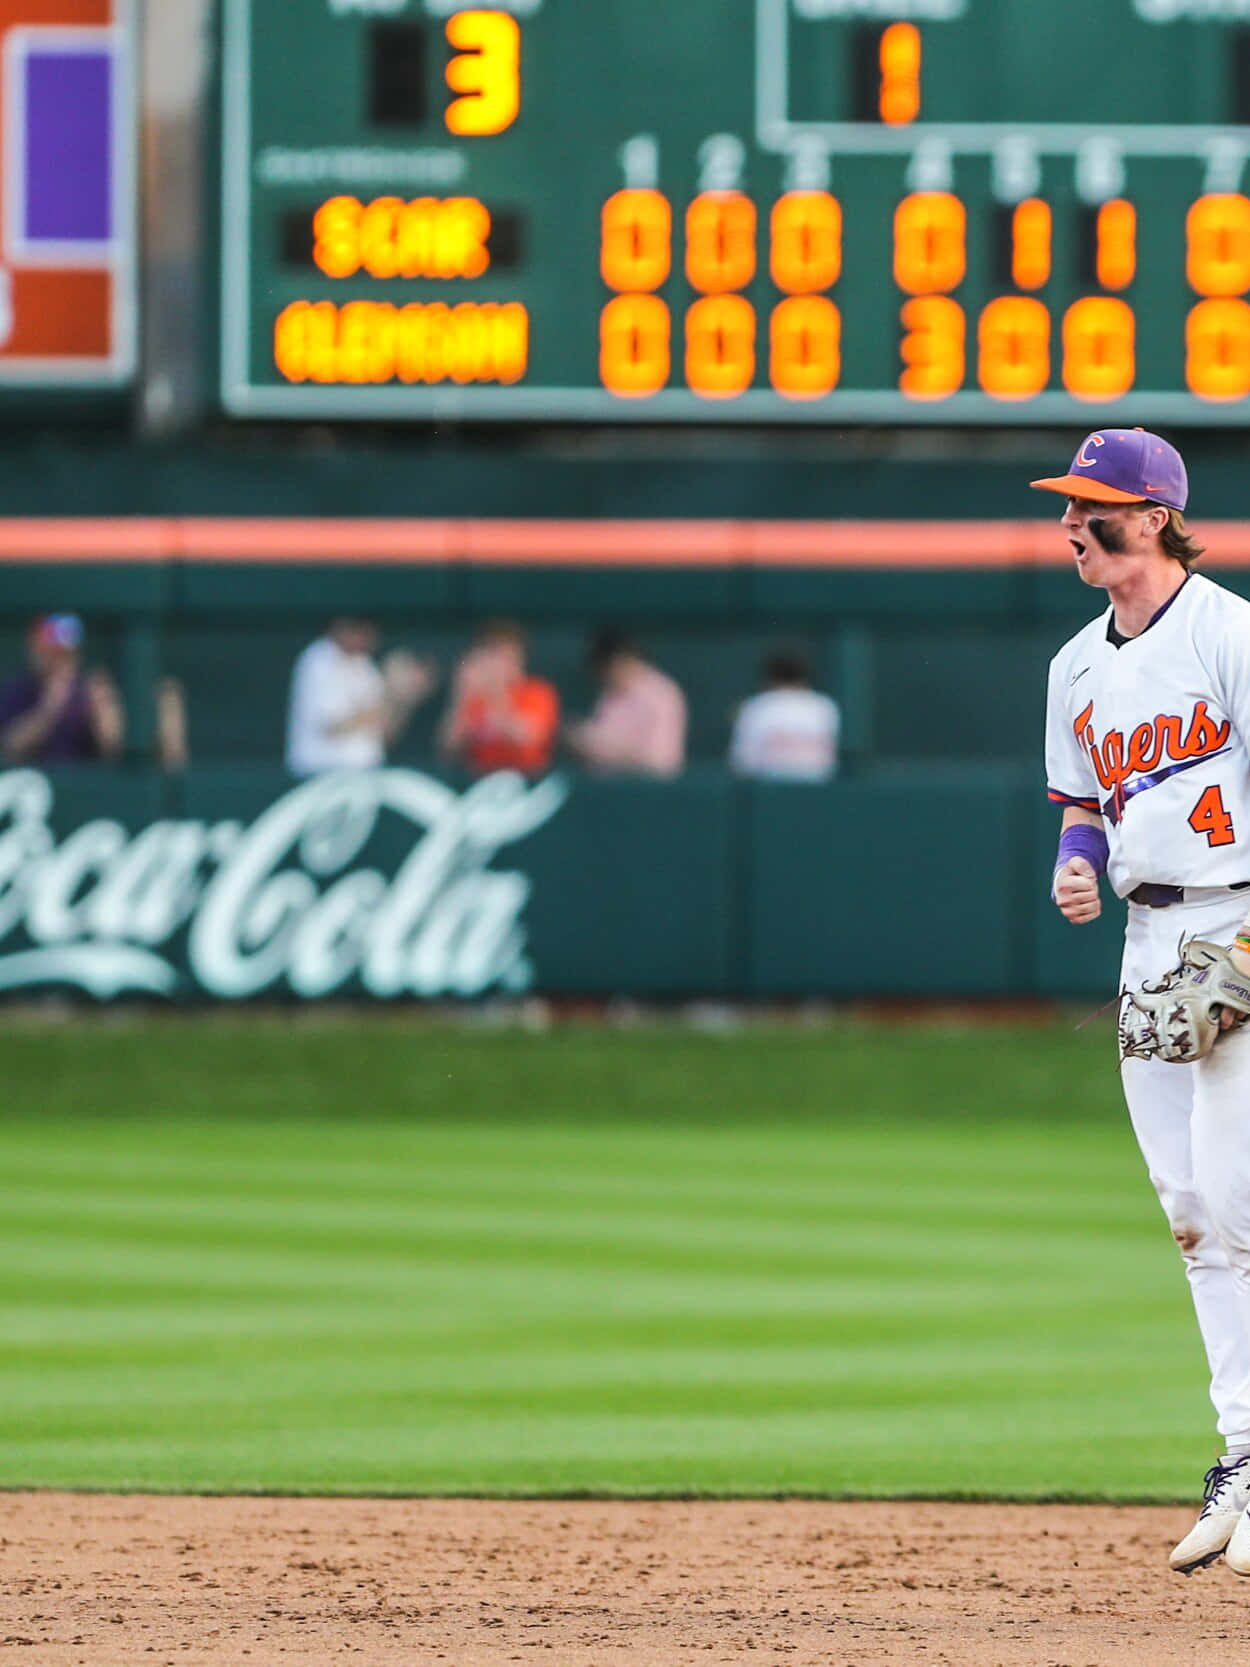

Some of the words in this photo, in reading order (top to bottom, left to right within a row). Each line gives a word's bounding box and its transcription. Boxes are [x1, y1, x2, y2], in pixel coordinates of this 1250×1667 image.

[444, 9, 521, 136] 3
[880, 22, 921, 126] 1
[600, 189, 672, 293] 0
[685, 190, 757, 294] 0
[769, 190, 843, 296] 0
[893, 192, 967, 296] 0
[1011, 198, 1052, 291] 1
[1097, 198, 1137, 291] 1
[600, 293, 672, 398] 0
[684, 294, 757, 398] 0
[768, 294, 842, 400] 0
[899, 296, 966, 401] 3
[977, 296, 1051, 401] 0
[1062, 296, 1136, 401] 0
[1075, 434, 1105, 468] C
[1073, 699, 1232, 825] Tigers
[1187, 784, 1236, 848] 4
